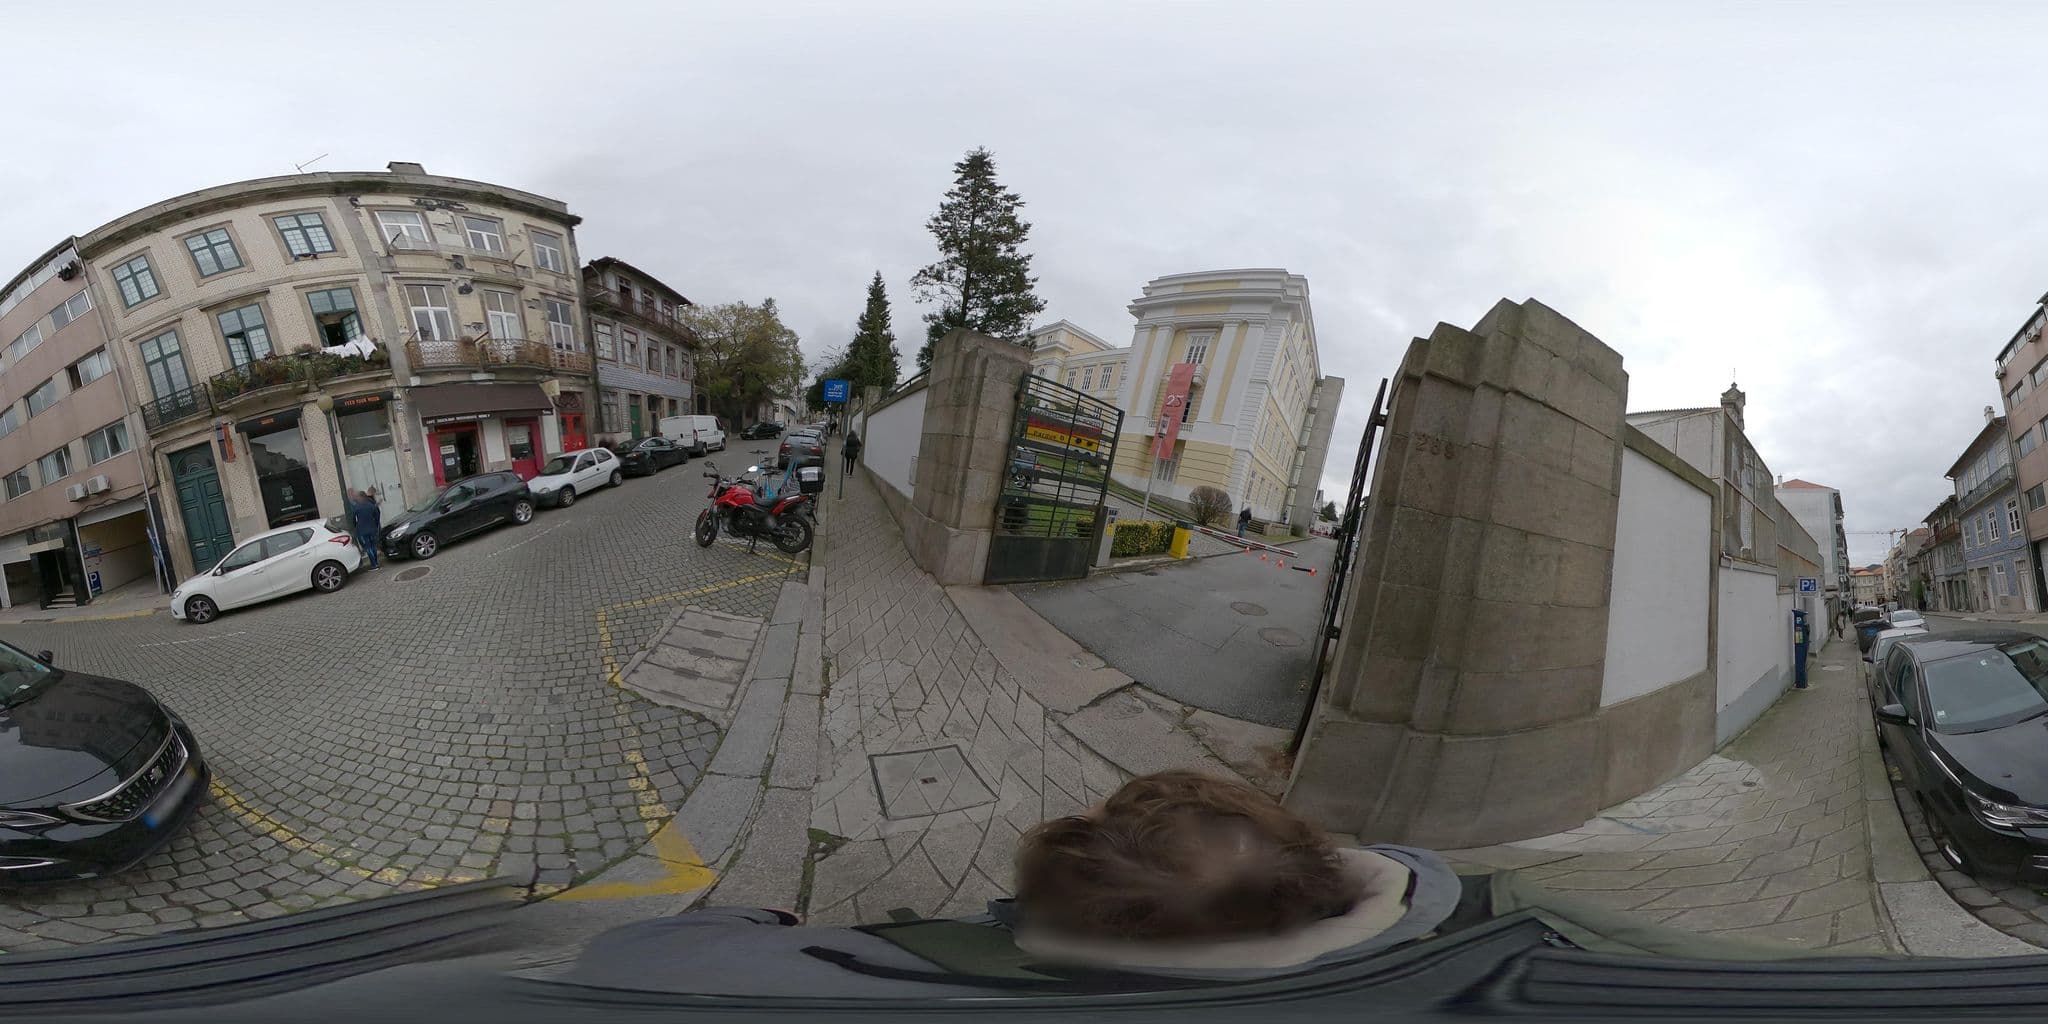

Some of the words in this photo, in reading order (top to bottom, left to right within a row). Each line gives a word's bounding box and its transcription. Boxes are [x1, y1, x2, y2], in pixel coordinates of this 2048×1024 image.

[1166, 394, 1185, 408] 25
[89, 572, 98, 588] P
[1801, 580, 1810, 591] P
